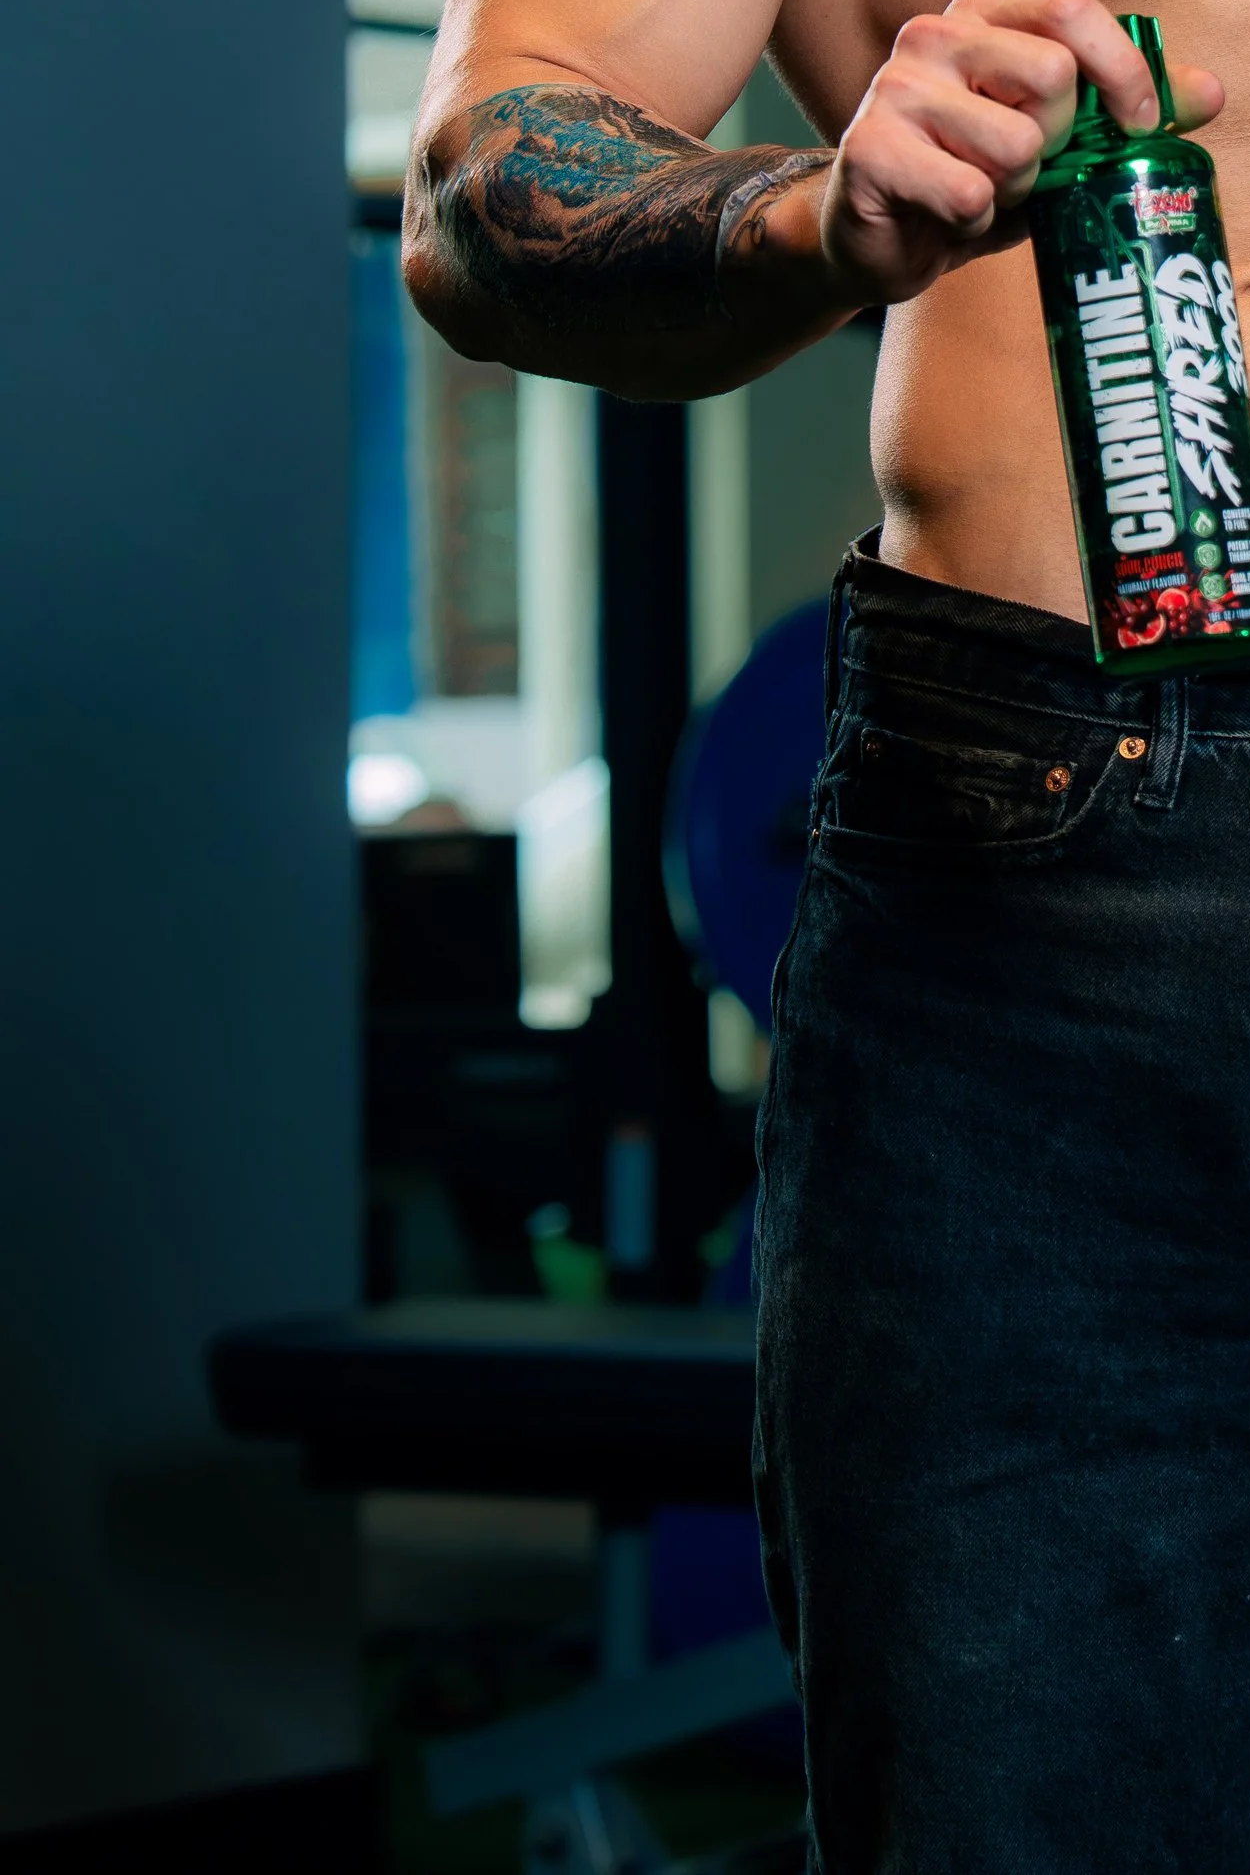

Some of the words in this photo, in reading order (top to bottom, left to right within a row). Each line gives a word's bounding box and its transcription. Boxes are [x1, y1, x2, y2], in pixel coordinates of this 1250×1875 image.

[1074, 263, 1177, 553] CARNITINE
[1153, 253, 1242, 507] SHRED
[1151, 573, 1188, 589] FLAVORED
